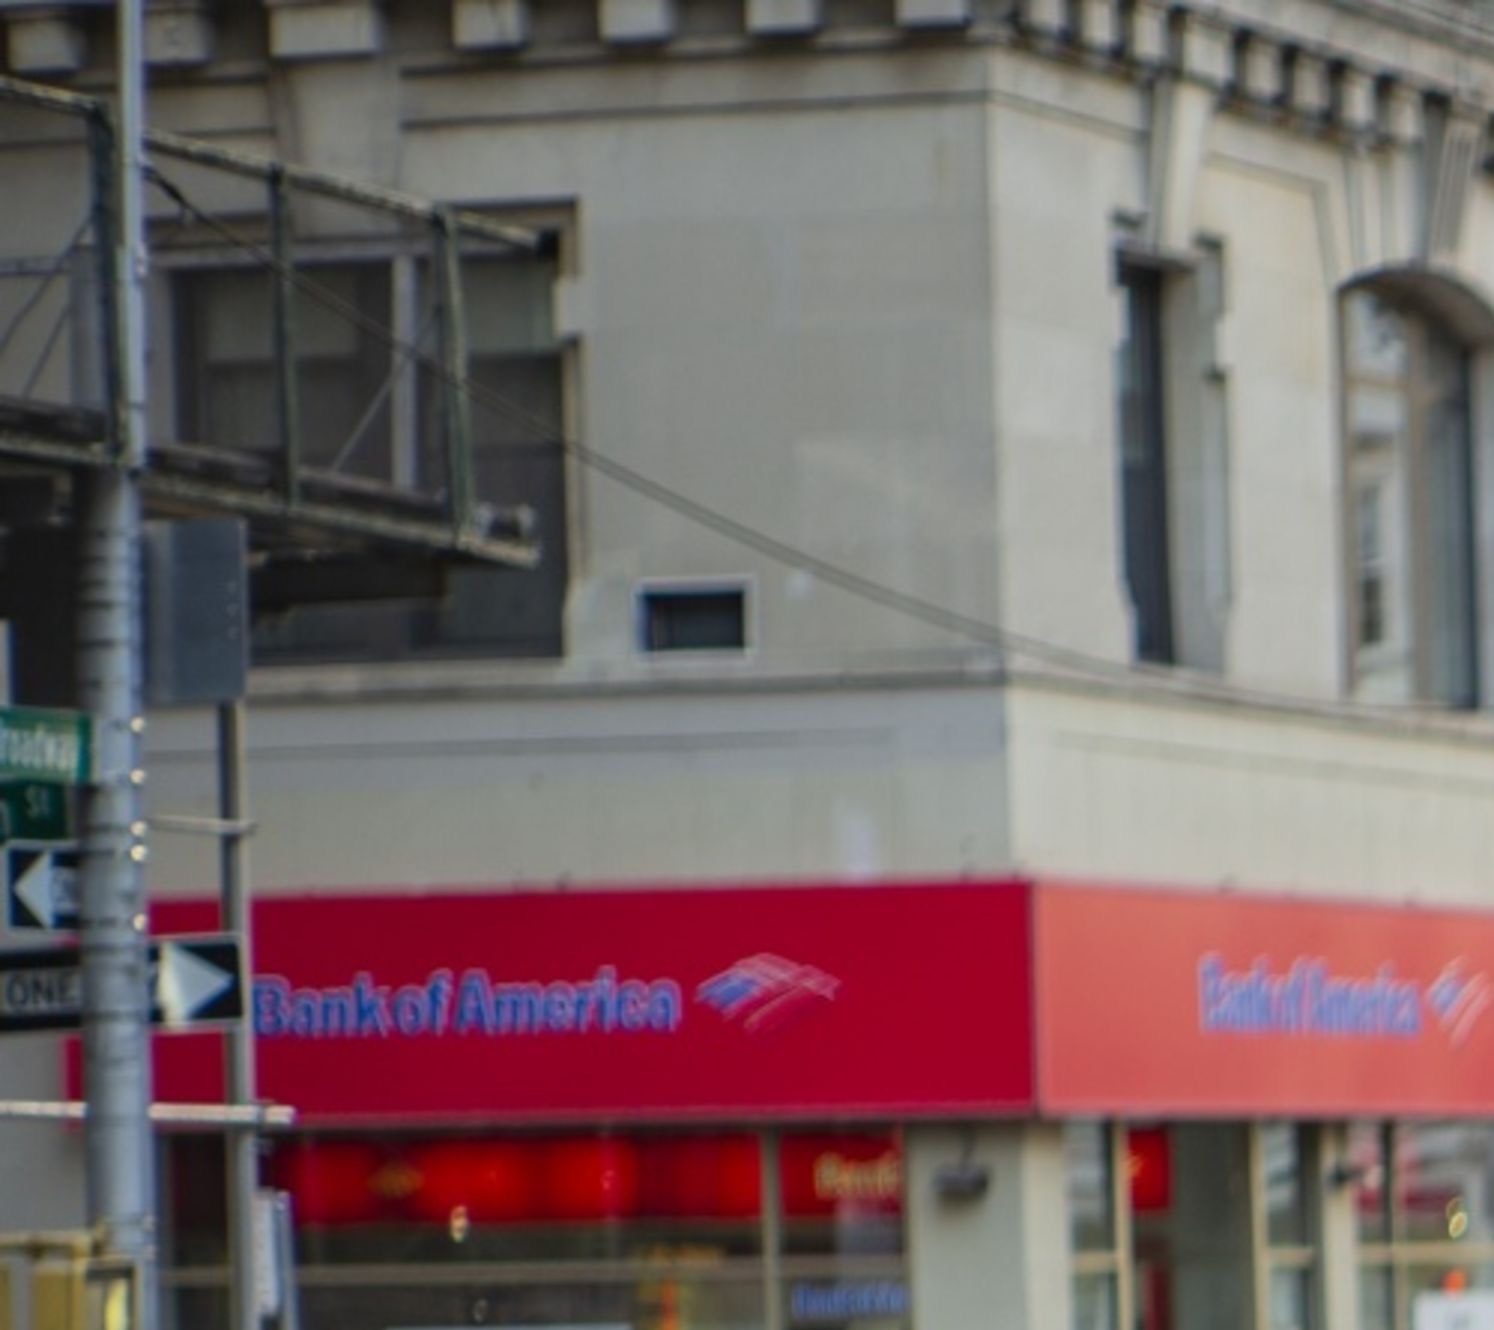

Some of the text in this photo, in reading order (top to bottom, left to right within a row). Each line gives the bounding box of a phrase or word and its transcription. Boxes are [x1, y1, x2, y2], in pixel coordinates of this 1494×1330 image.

[252, 965, 682, 1037] Bank of America
[1197, 950, 1272, 1036] Bank
[1307, 956, 1422, 1038] America
